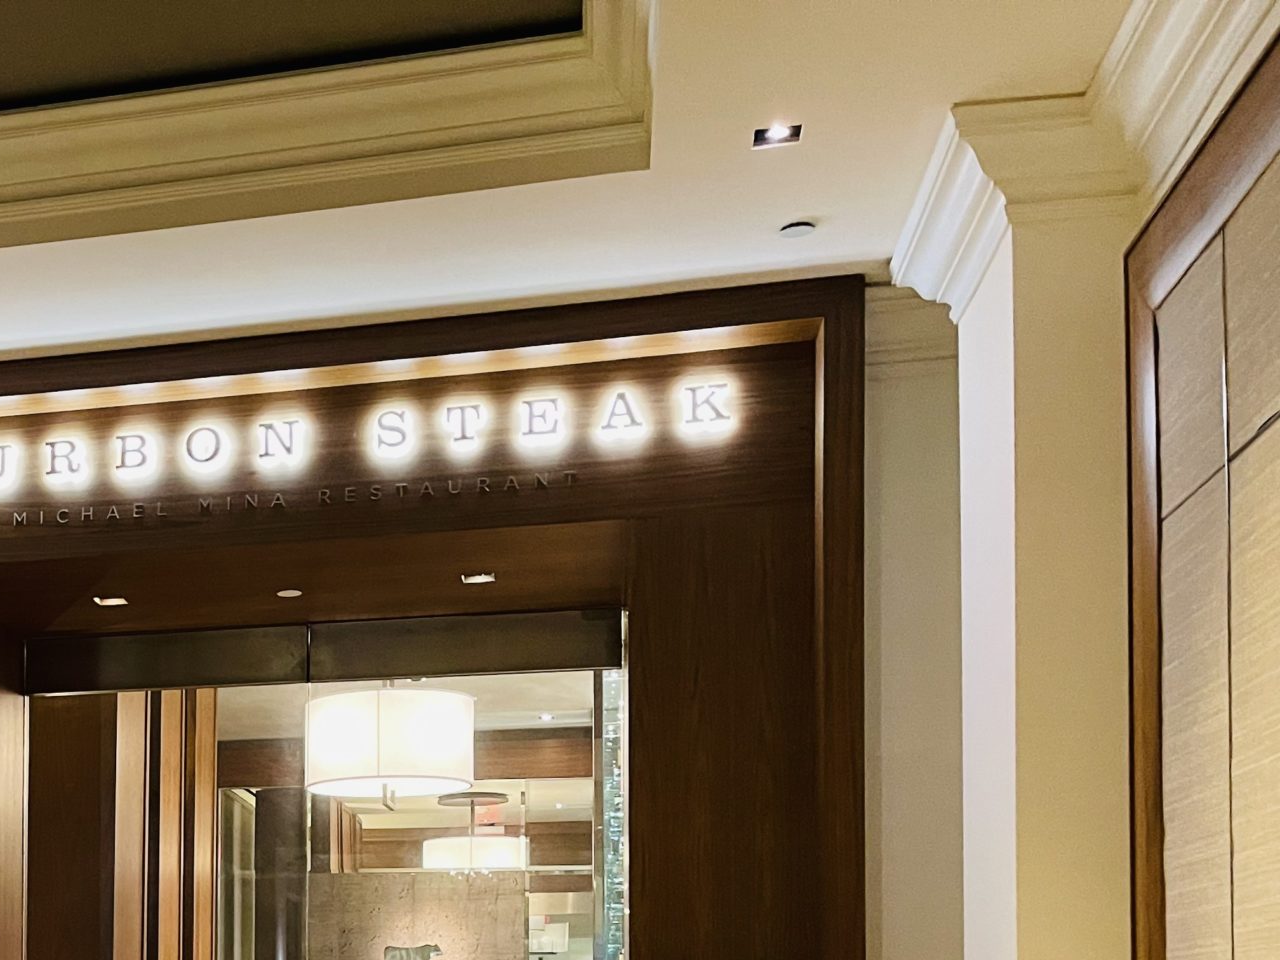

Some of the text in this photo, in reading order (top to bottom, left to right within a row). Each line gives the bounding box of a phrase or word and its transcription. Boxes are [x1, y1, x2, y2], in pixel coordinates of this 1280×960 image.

[376, 382, 731, 450] STEAK
[12, 500, 168, 526] MICHAEL
[199, 492, 287, 512] MINA
[317, 470, 580, 504] RESTAURANT
